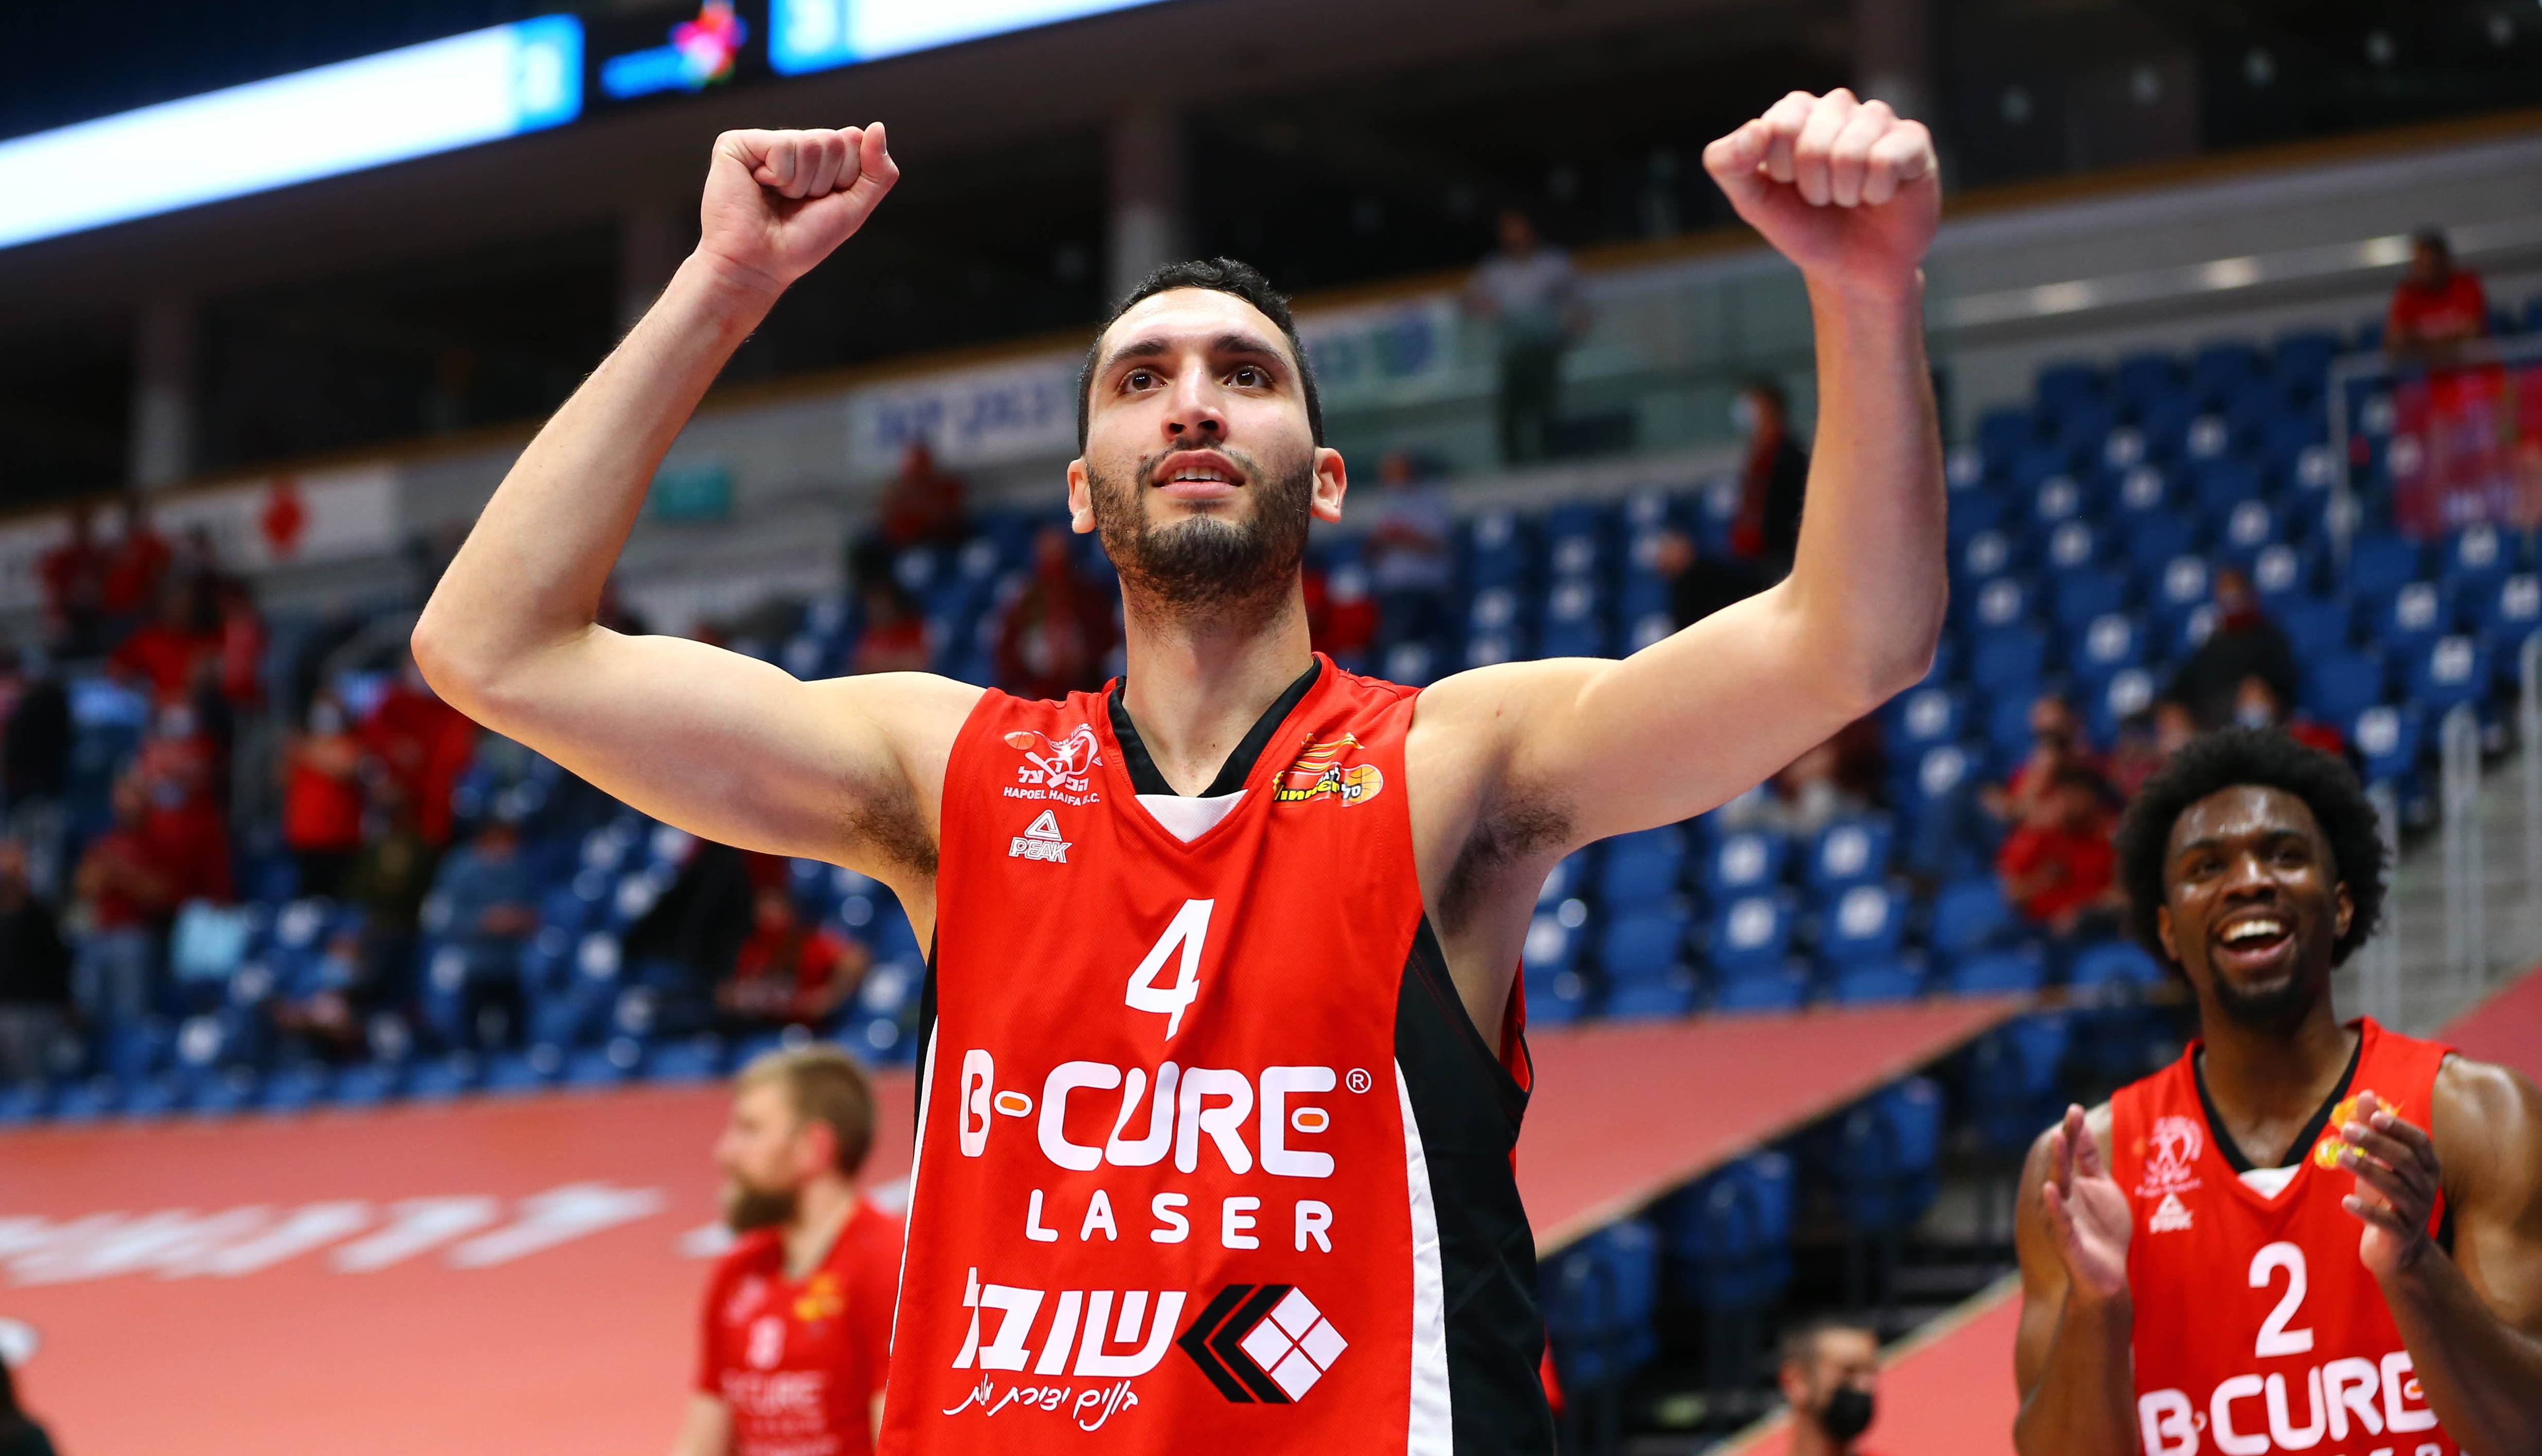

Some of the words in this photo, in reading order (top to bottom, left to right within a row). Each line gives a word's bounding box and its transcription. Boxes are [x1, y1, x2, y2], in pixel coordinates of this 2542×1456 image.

[1003, 787, 1047, 800] HAPOEL
[1048, 789, 1081, 806] HAIFA
[1082, 793, 1100, 805] B.C.
[1008, 836, 1073, 864] PEAK
[1124, 898, 1214, 1042] 4
[959, 1048, 1337, 1178] B-CURE
[1025, 1189, 1333, 1253] LASER
[951, 1267, 1187, 1377] שובל
[2248, 1241, 2314, 1358] 2
